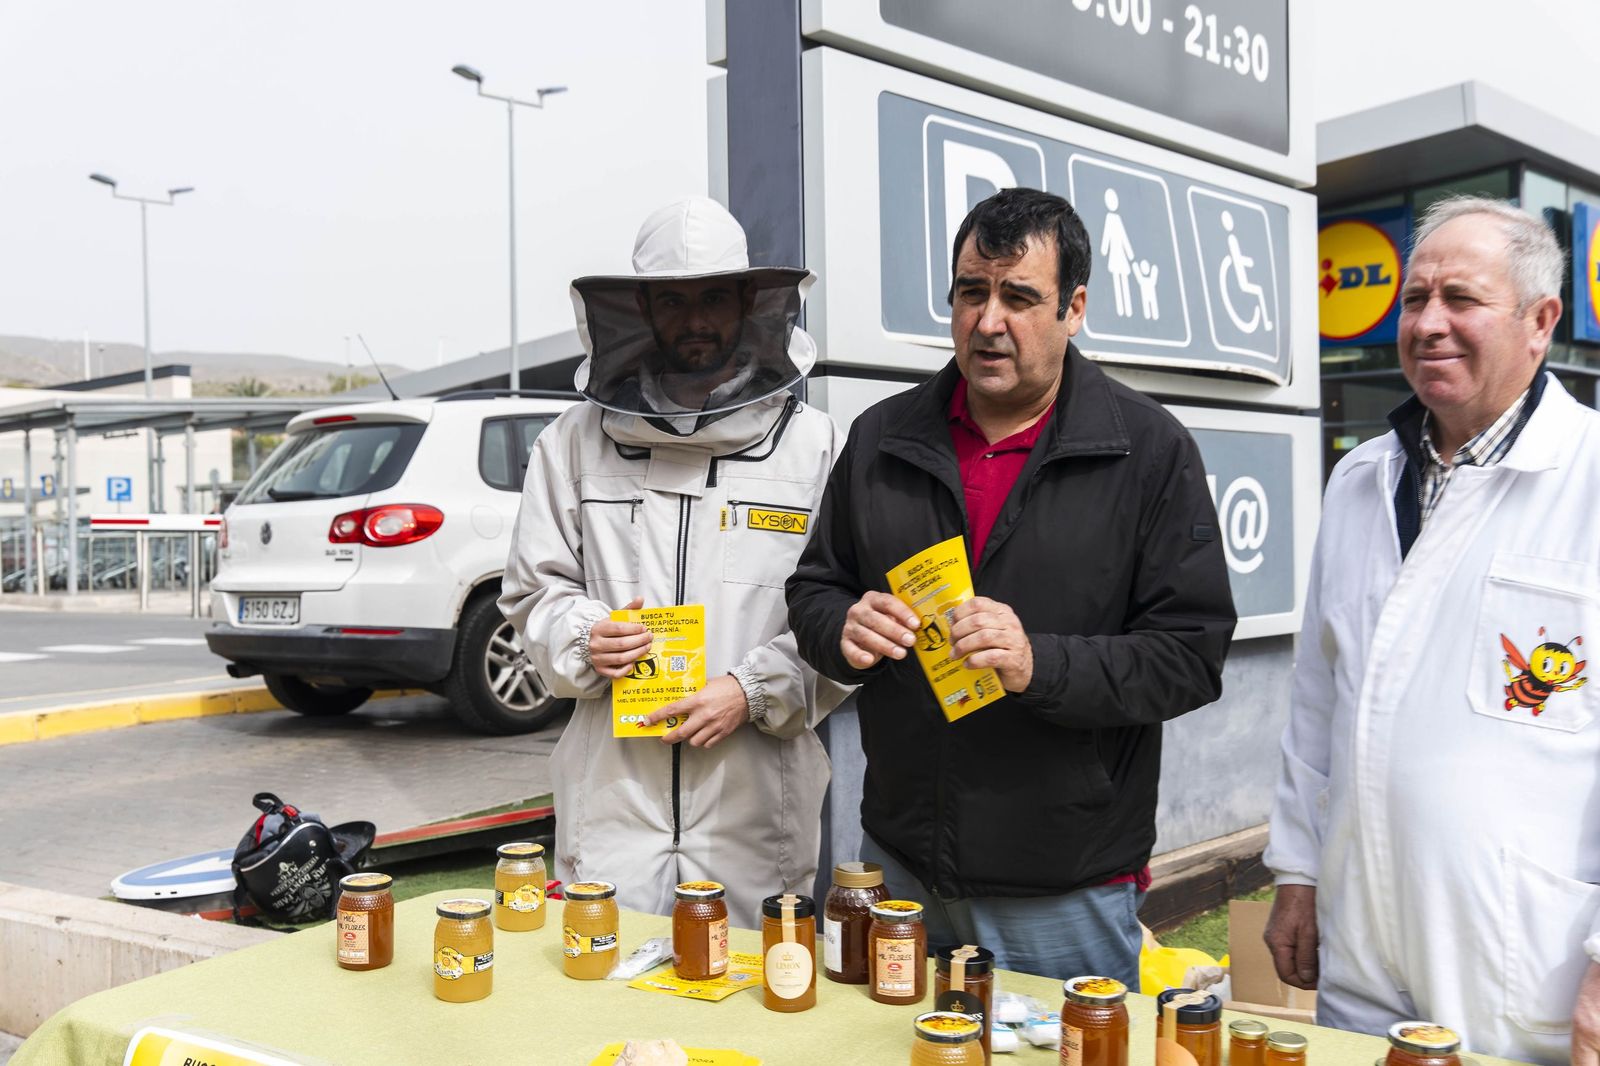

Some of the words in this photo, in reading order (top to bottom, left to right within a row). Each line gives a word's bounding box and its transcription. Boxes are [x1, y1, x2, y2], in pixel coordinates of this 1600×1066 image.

[1071, 0, 1151, 35] :00
[1184, 4, 1269, 82] 21:30
[111, 479, 128, 499] P
[750, 513, 805, 530] LYSON
[244, 601, 269, 619] 5150
[272, 601, 296, 619] GZJ
